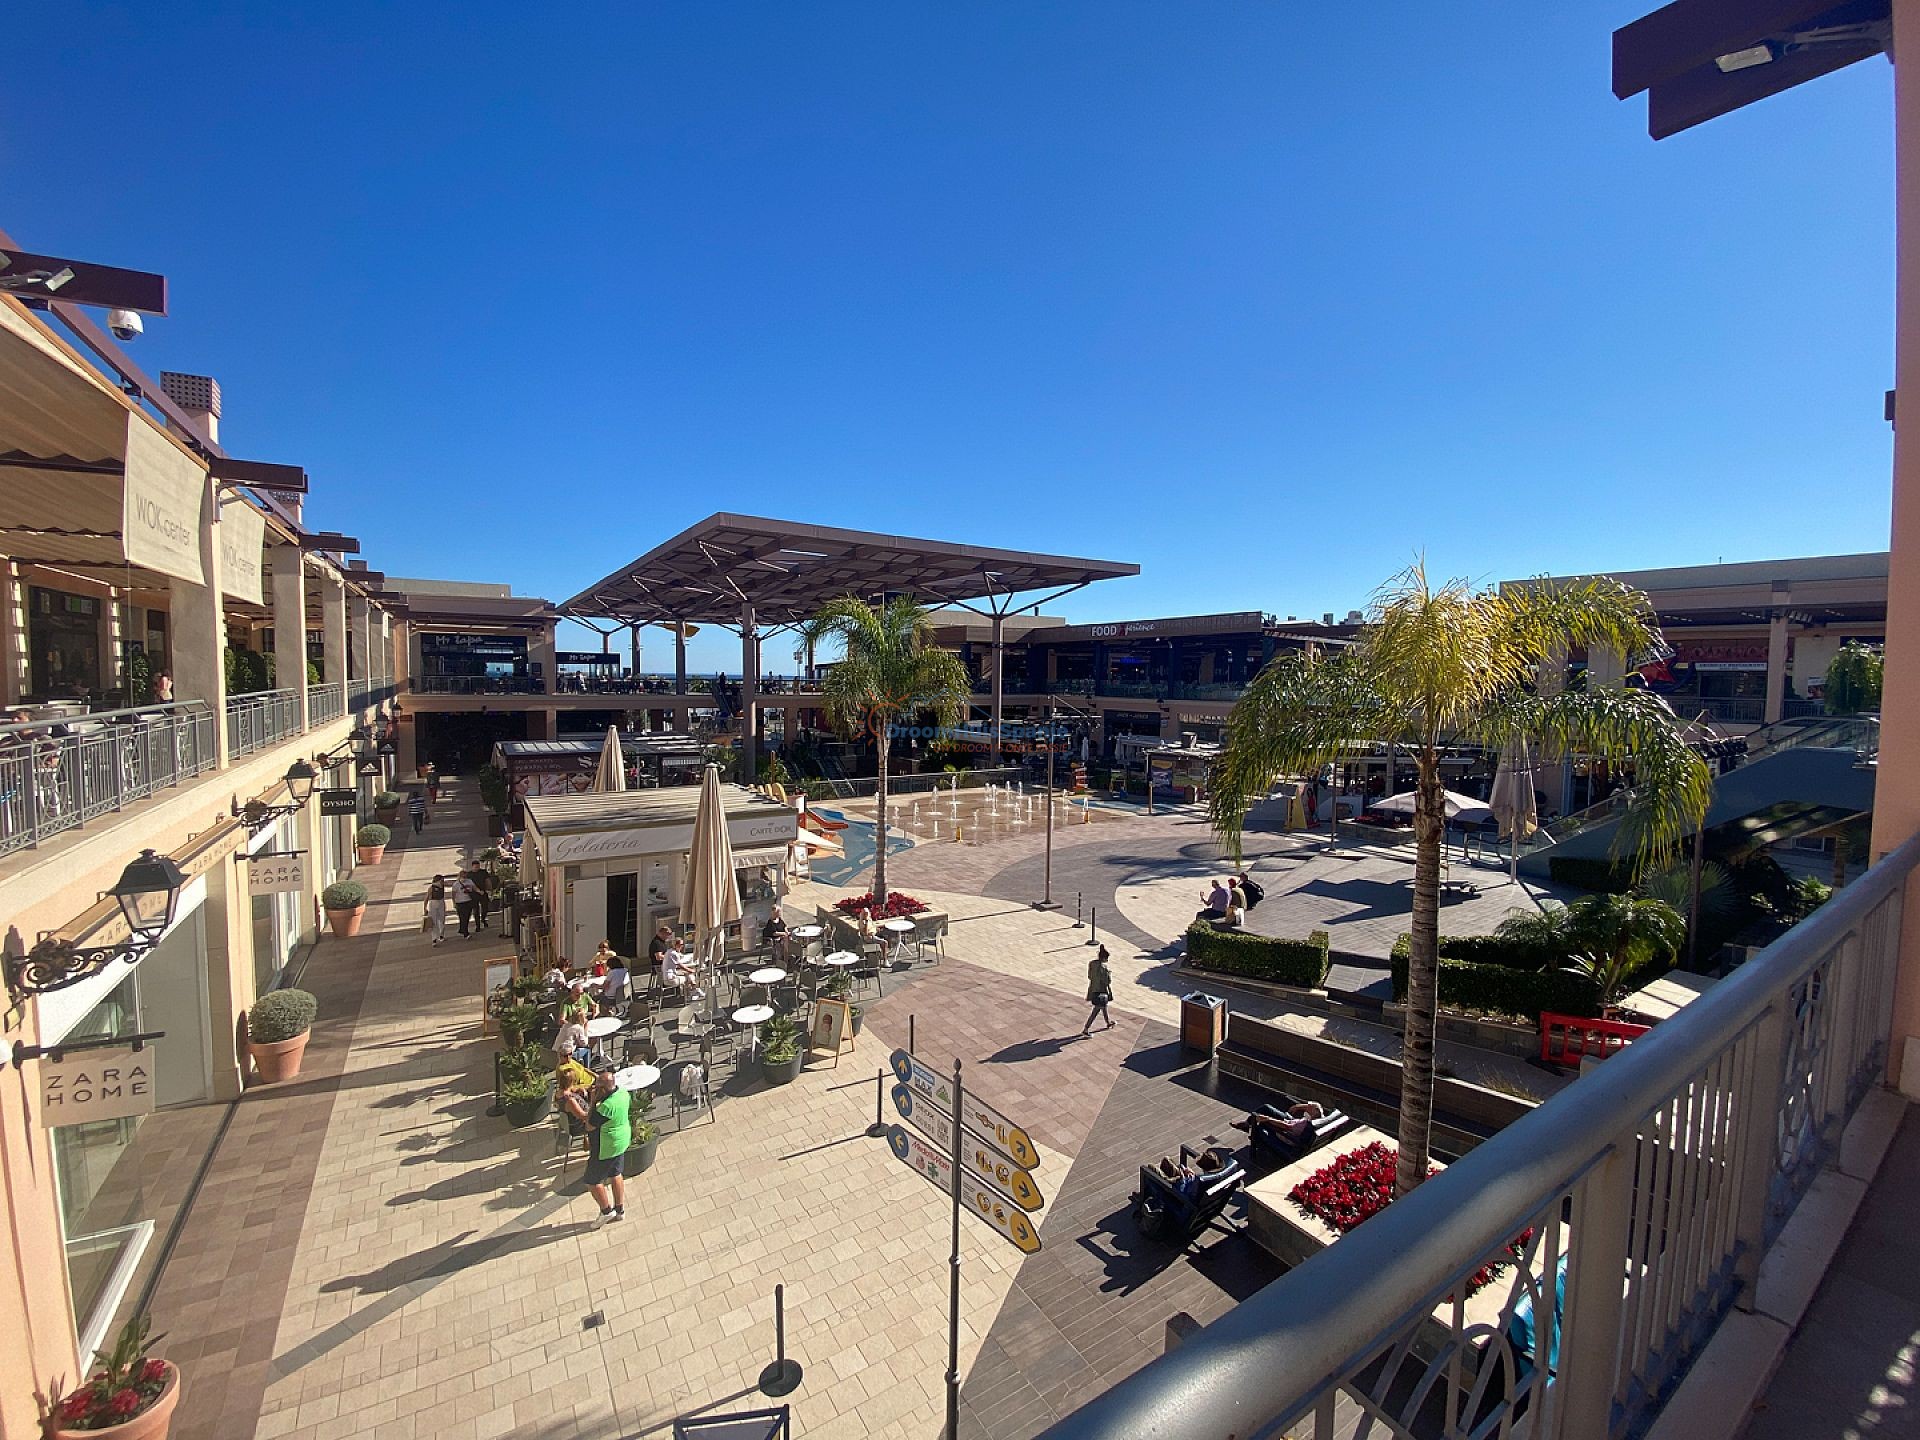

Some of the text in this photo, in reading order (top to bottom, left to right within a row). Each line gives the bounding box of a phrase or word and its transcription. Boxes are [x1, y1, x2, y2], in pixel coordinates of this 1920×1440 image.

[1091, 626, 1117, 637] FOOD
[323, 799, 354, 807] OYSHO
[556, 834, 641, 861] Gelateria
[250, 865, 301, 878] ZARA
[250, 874, 301, 885] HOME
[47, 1065, 147, 1089] ZARA
[46, 1081, 148, 1106] HOME
